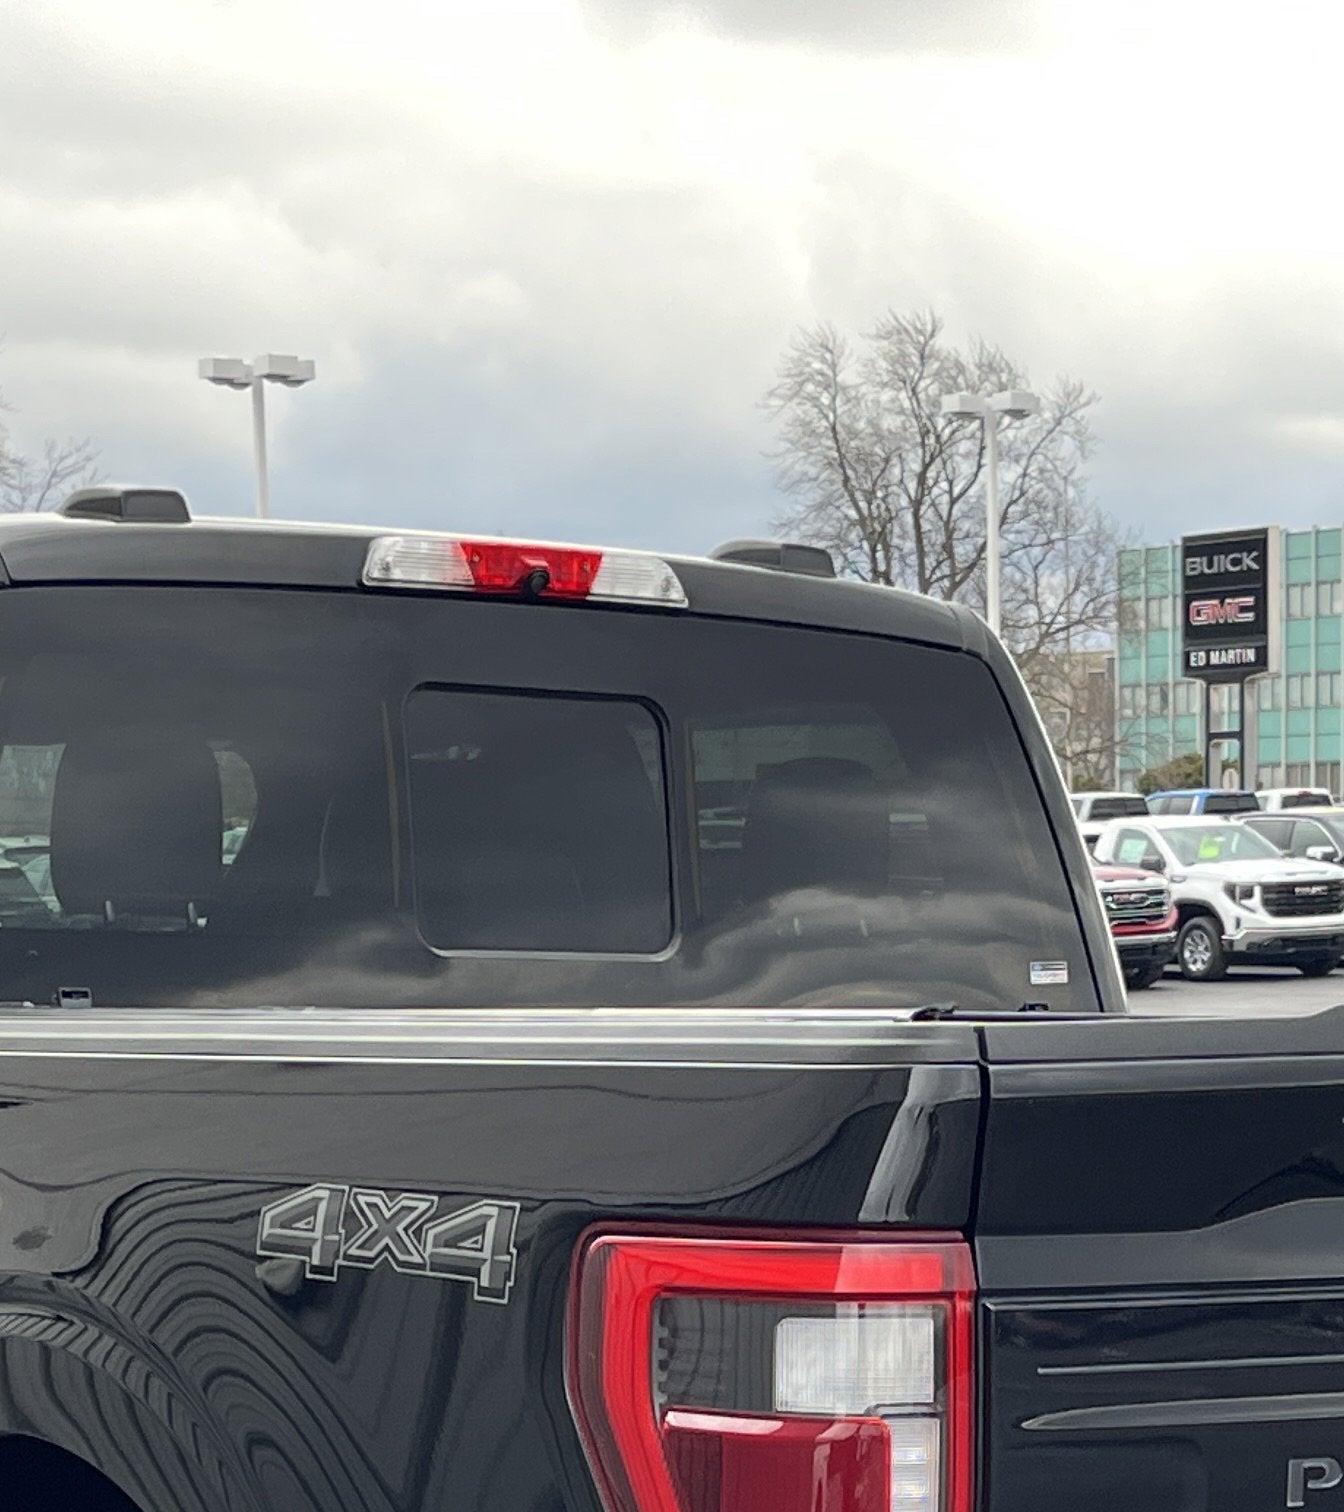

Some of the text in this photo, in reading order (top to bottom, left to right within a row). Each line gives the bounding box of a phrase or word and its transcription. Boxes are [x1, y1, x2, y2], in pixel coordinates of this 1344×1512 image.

[1184, 551, 1260, 576] BUICK
[1189, 596, 1255, 625] GMC
[1189, 648, 1256, 667] ED MARTIN
